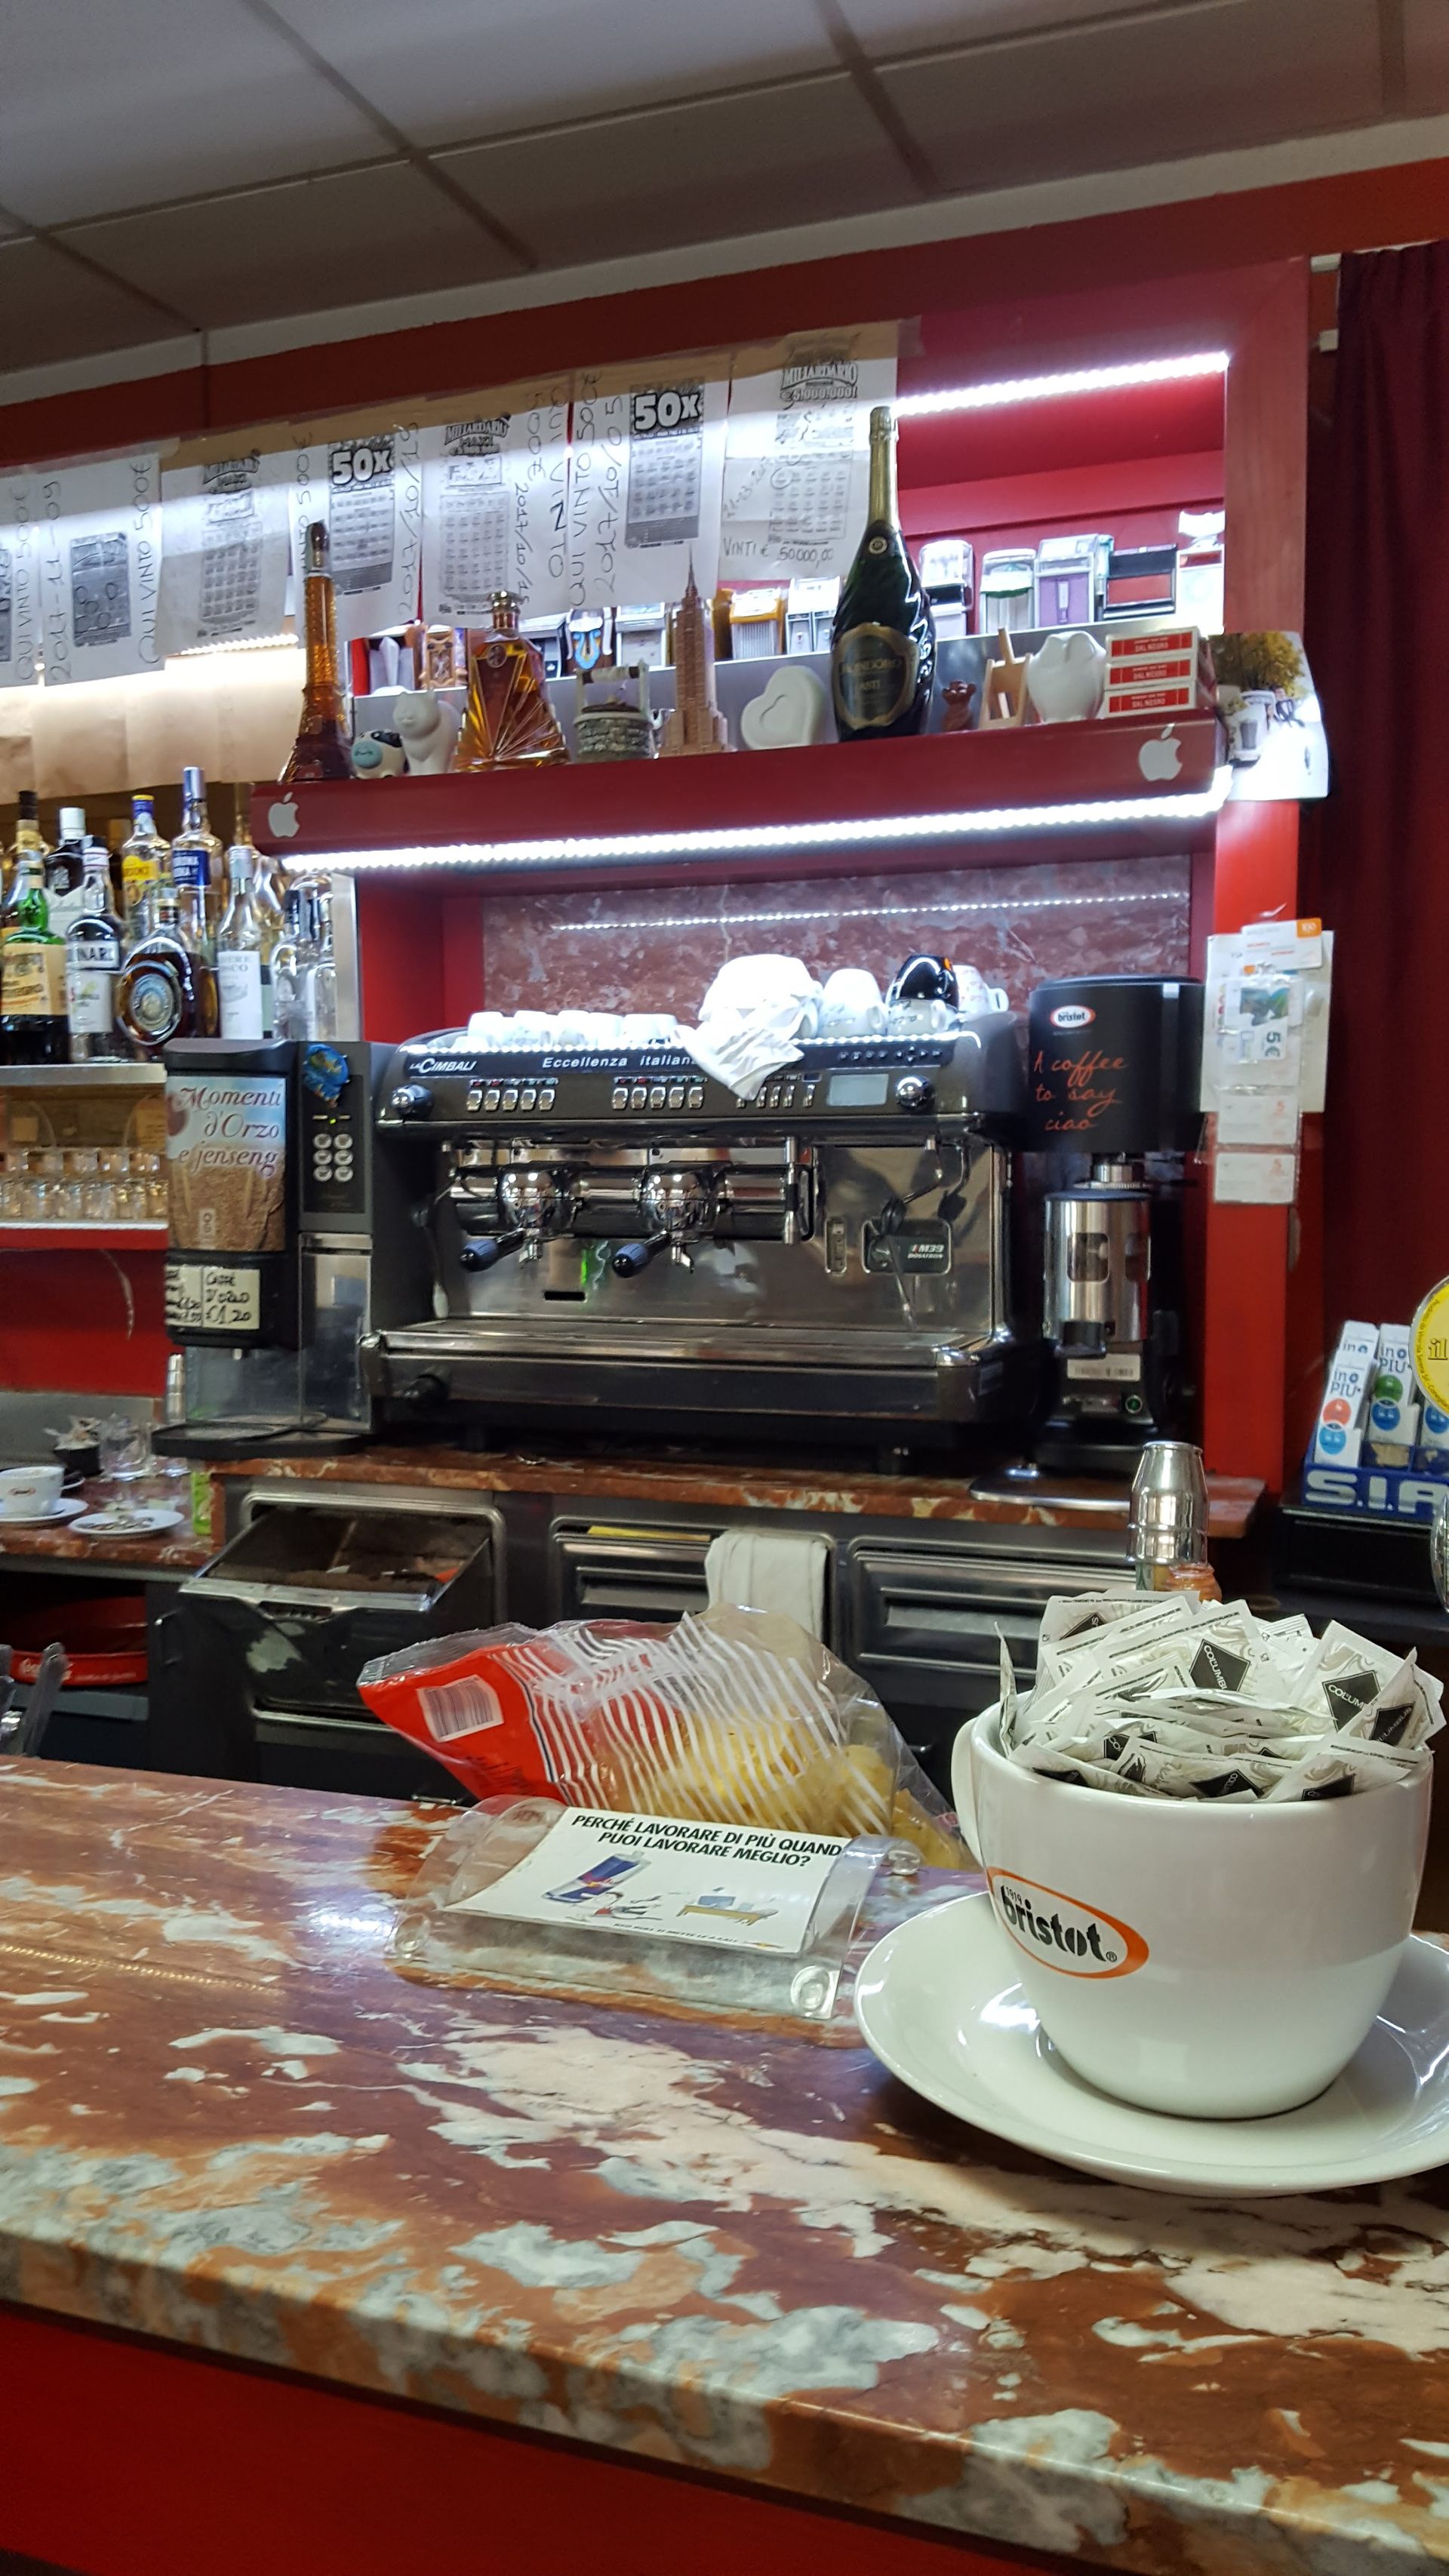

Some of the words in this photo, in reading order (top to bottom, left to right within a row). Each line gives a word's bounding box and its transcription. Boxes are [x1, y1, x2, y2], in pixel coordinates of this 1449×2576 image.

[574, 452, 592, 537] VINTO
[137, 540, 157, 601] VINTO
[570, 552, 586, 607] QUI
[17, 569, 32, 628] VINTO
[16, 634, 34, 680] QUI
[138, 610, 161, 664] QUI
[542, 1056, 628, 1069] Eccellenza
[1051, 1050, 1126, 1087] coffee
[177, 1085, 282, 1109] Momenti
[1035, 1084, 1055, 1101] to
[1069, 1088, 1122, 1117] say
[203, 1109, 280, 1139] d'Orzo
[1044, 1111, 1095, 1131] ciao
[1204, 1645, 1228, 1691] COLUMB
[1328, 1684, 1365, 1710] COLUM
[571, 1814, 635, 1833] PERCHÉ
[635, 1821, 721, 1842] LAVORARE
[723, 1831, 743, 1845] DI
[745, 1833, 775, 1848] PIÙ
[778, 1839, 843, 1857] QUAND
[597, 1832, 643, 1847] PUOI
[643, 1836, 731, 1857] LAVORARE
[732, 1846, 812, 1867] MEGLIO?
[1005, 1886, 1023, 1904] 1919
[1001, 1885, 1106, 1962] bristot
